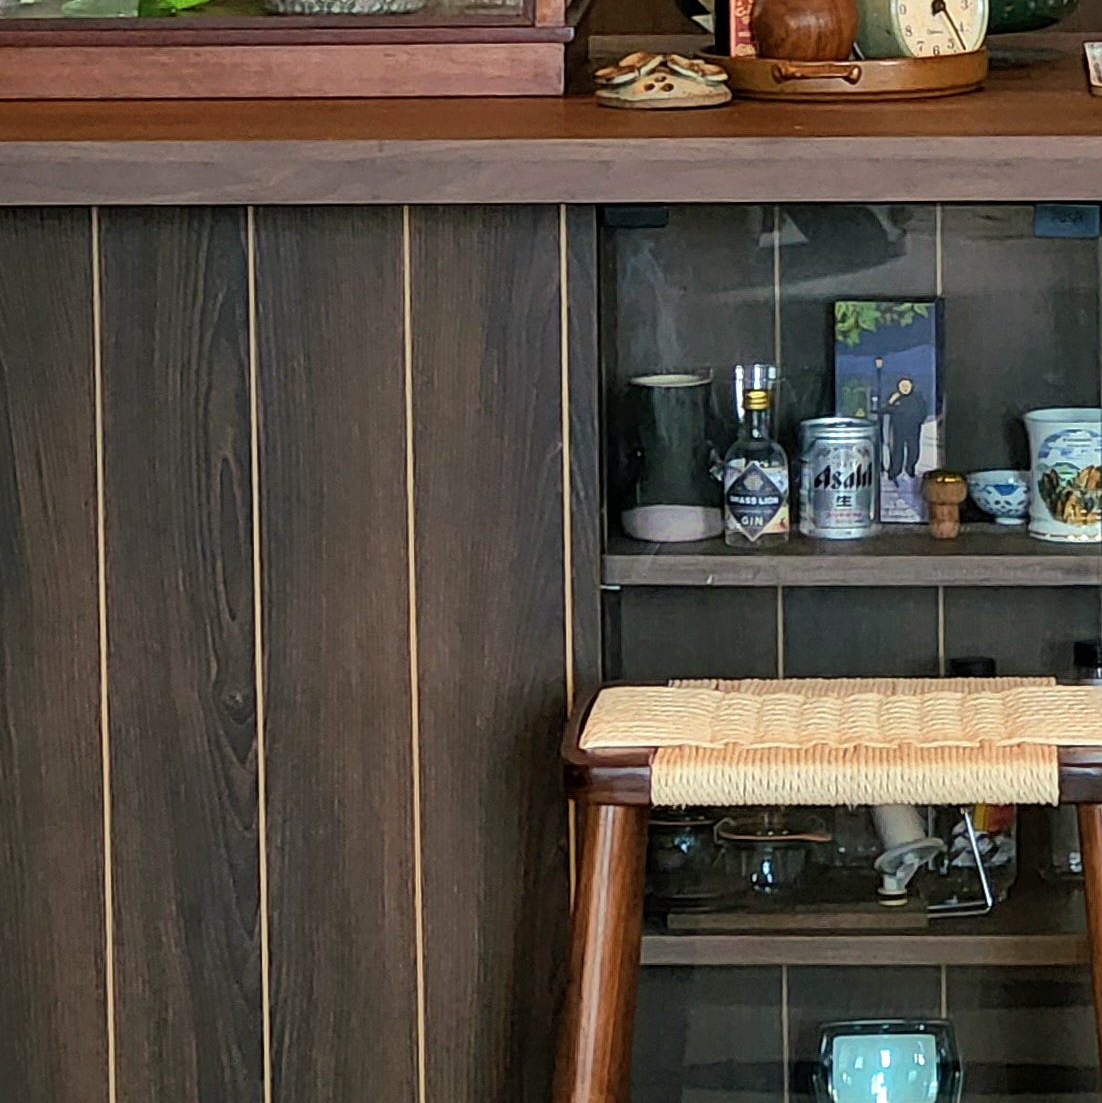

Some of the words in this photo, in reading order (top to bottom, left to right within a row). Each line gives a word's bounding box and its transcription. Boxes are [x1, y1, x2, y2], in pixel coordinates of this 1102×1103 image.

[961, 0, 970, 10] 3
[905, 25, 913, 37] 8
[917, 40, 925, 51] 7
[947, 38, 955, 49] 5
[932, 44, 941, 55] 6
[813, 463, 873, 490] Asahi
[836, 495, 853, 507] 生
[741, 516, 763, 527] GIN
